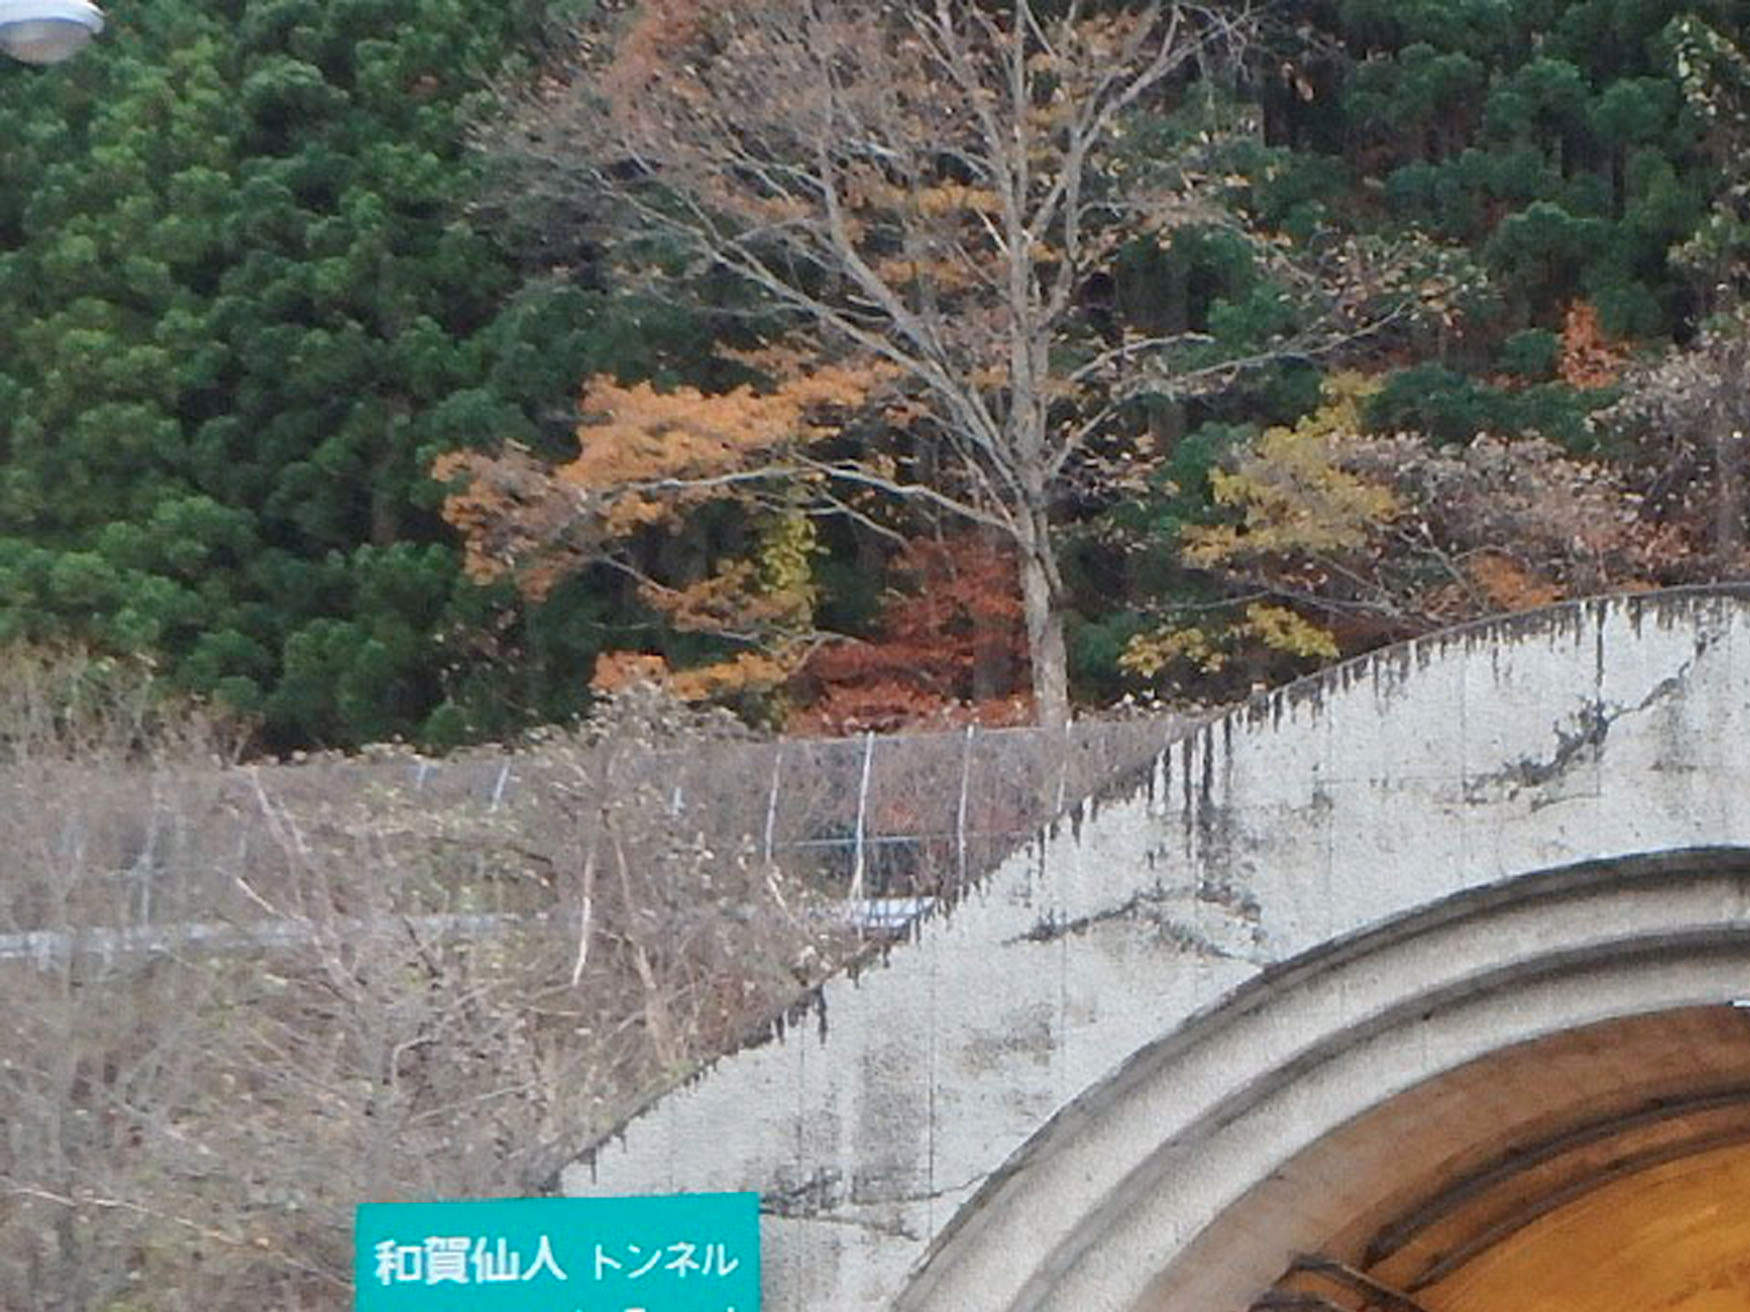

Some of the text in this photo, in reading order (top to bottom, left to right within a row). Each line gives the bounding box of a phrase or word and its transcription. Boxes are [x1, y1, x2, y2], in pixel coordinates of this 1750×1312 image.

[374, 1235, 739, 1286] 和賀仙人 トンネル
